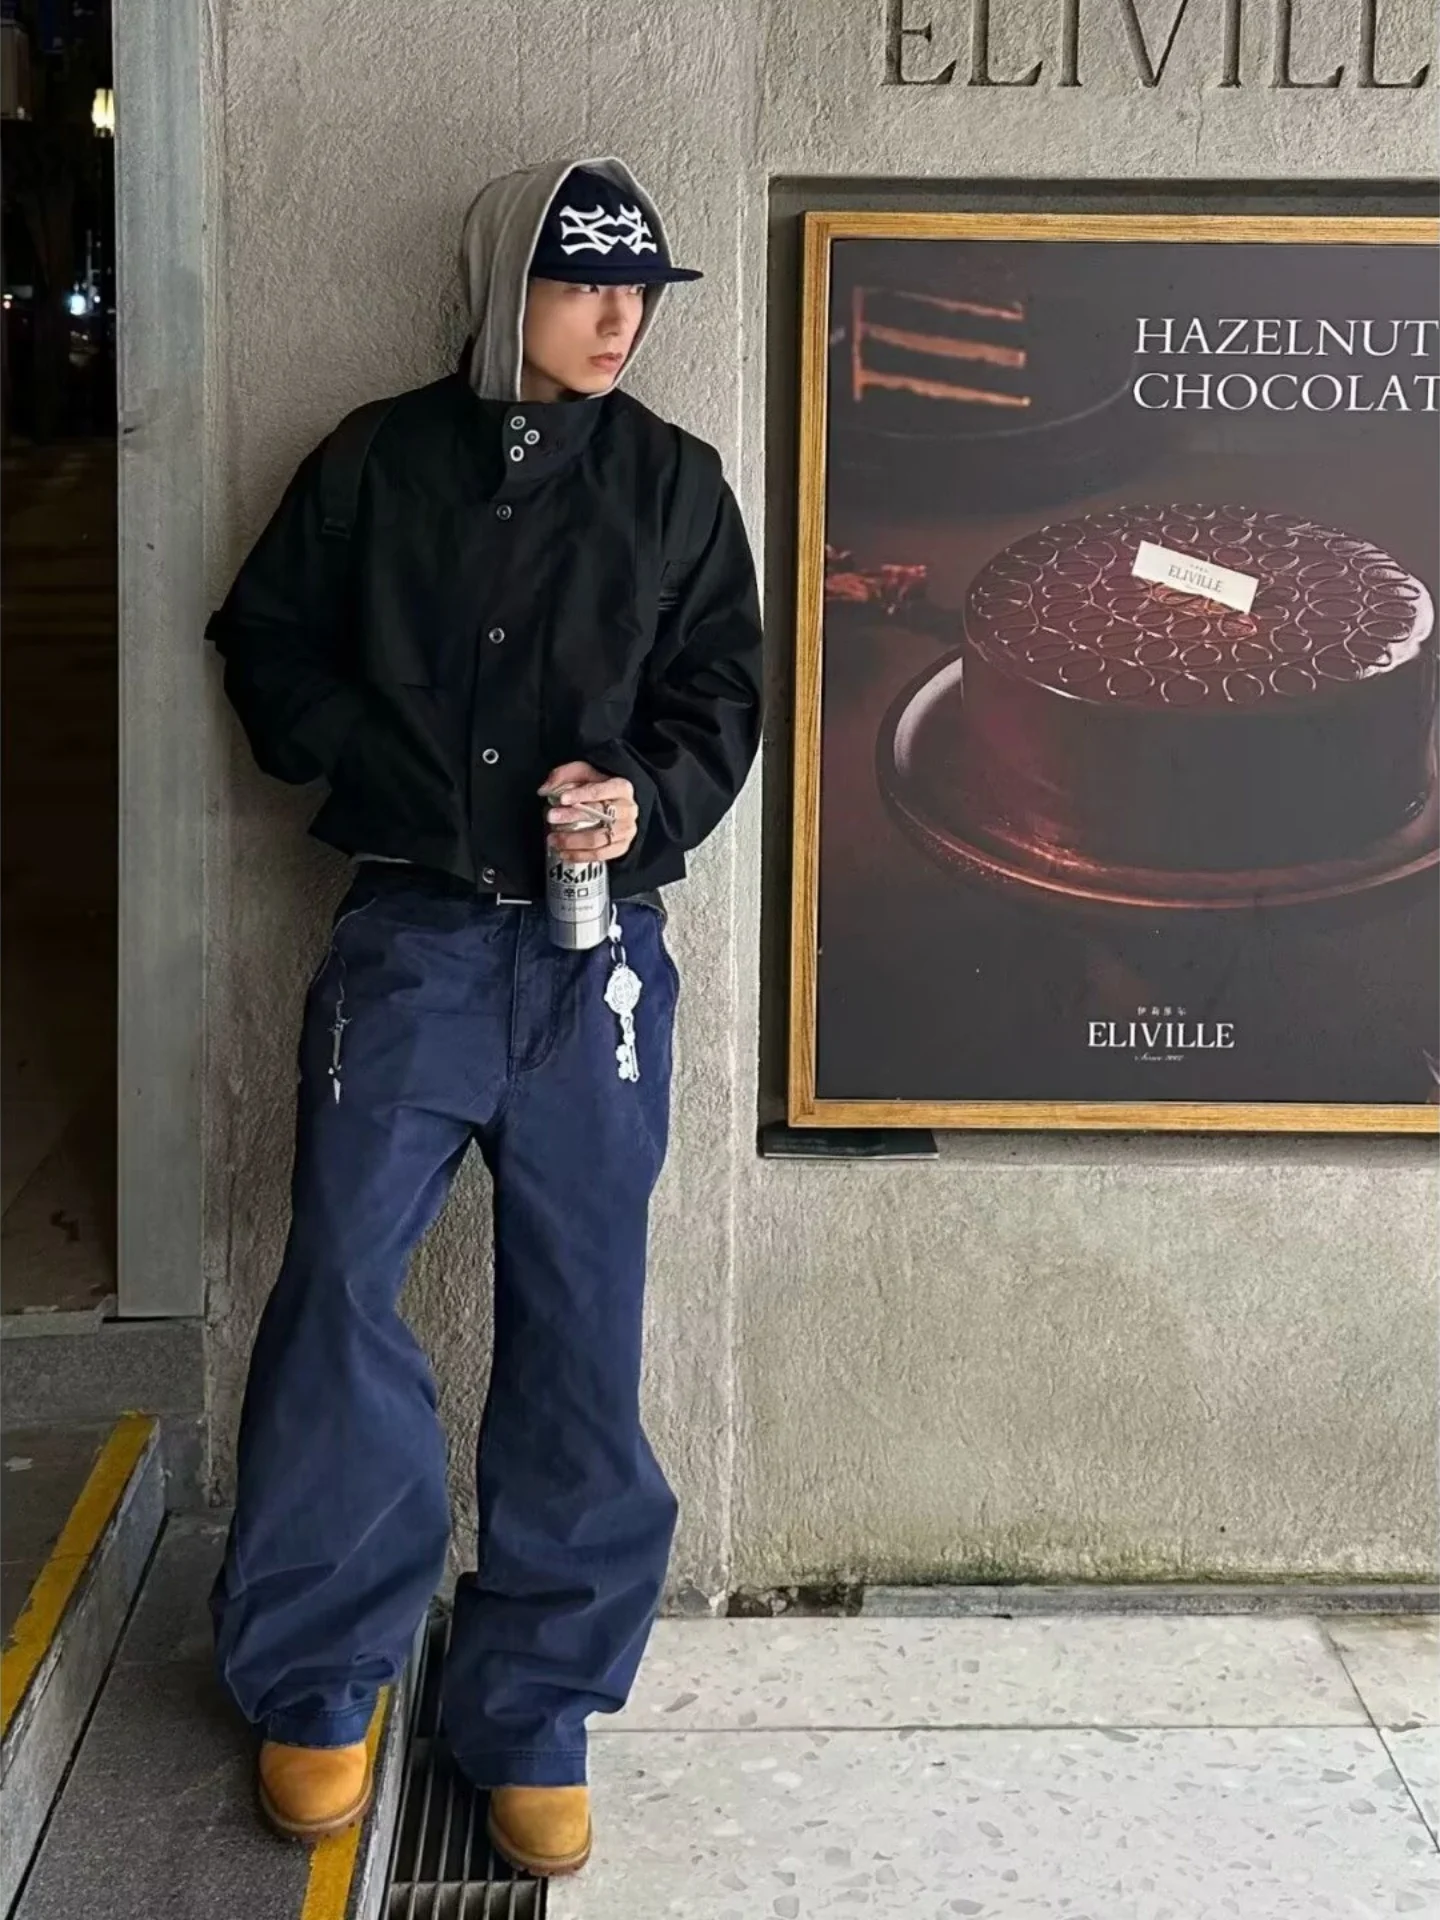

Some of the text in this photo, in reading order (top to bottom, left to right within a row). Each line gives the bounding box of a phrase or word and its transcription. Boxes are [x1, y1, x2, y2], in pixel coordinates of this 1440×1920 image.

[1134, 317, 1439, 357] HAZELNUT
[1133, 373, 1440, 412] CHOCOLAT
[1168, 564, 1223, 593] ELIVILLE
[1088, 1021, 1235, 1049] ELIVILLE
